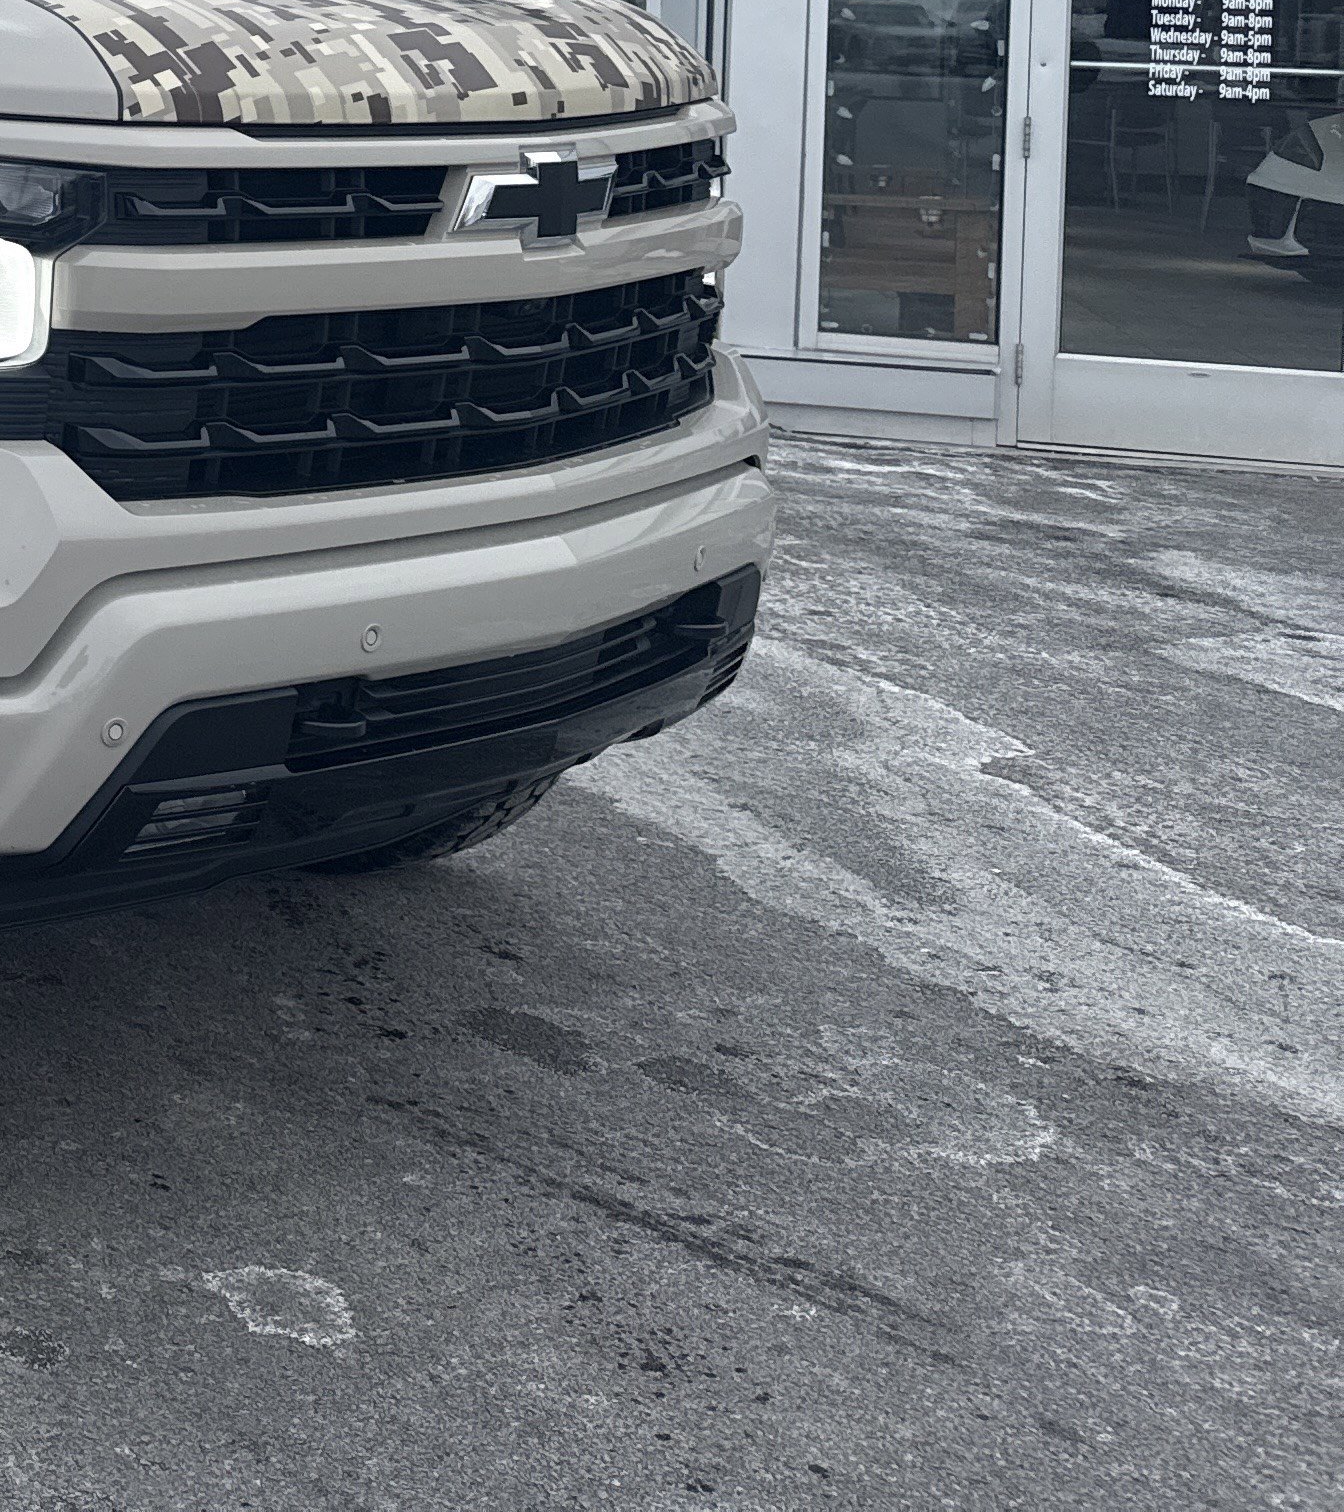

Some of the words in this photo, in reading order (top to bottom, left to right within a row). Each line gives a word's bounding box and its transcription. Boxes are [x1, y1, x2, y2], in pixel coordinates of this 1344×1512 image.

[1150, 9, 1196, 30] Tuesday
[1221, 12, 1273, 31] 9am-8pm
[1150, 27, 1212, 48] Wednesday
[1220, 29, 1272, 50] 9am-5pm
[1149, 44, 1200, 66] Thursday
[1219, 47, 1271, 68] 9am-8pm
[1219, 65, 1271, 85] 9am-8pm
[1148, 80, 1198, 101] Saturday
[1218, 83, 1270, 104] 9am-4pm
